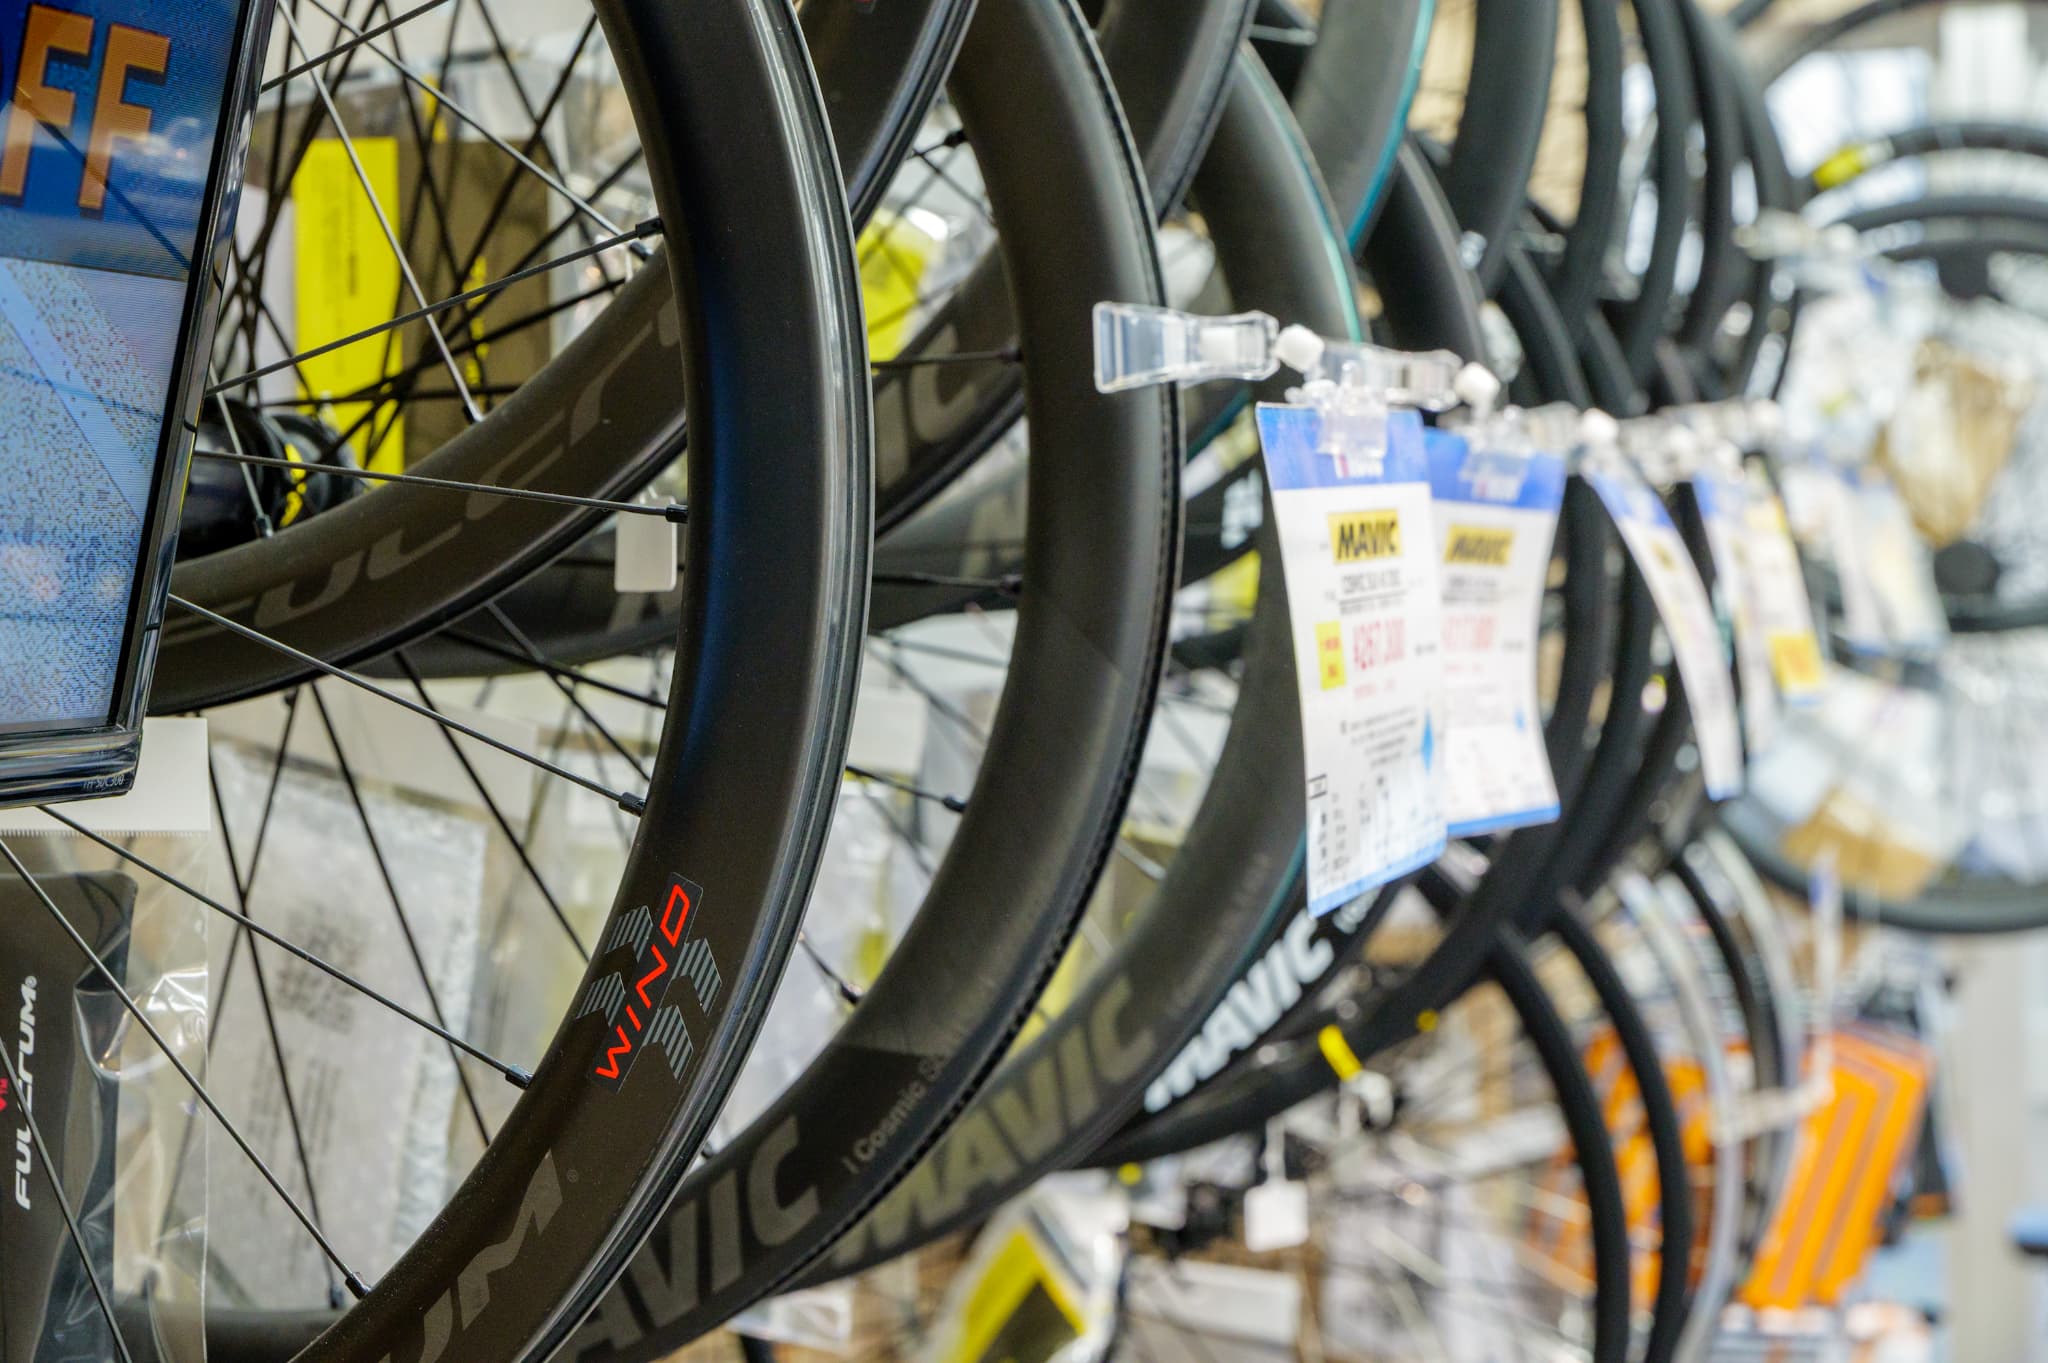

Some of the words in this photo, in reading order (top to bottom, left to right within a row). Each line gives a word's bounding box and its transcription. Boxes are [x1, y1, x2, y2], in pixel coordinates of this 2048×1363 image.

[1335, 519, 1399, 561] MAVIC
[594, 884, 690, 1079] WIND
[853, 1079, 927, 1162] Cosmic
[566, 1114, 821, 1363] AVIC
